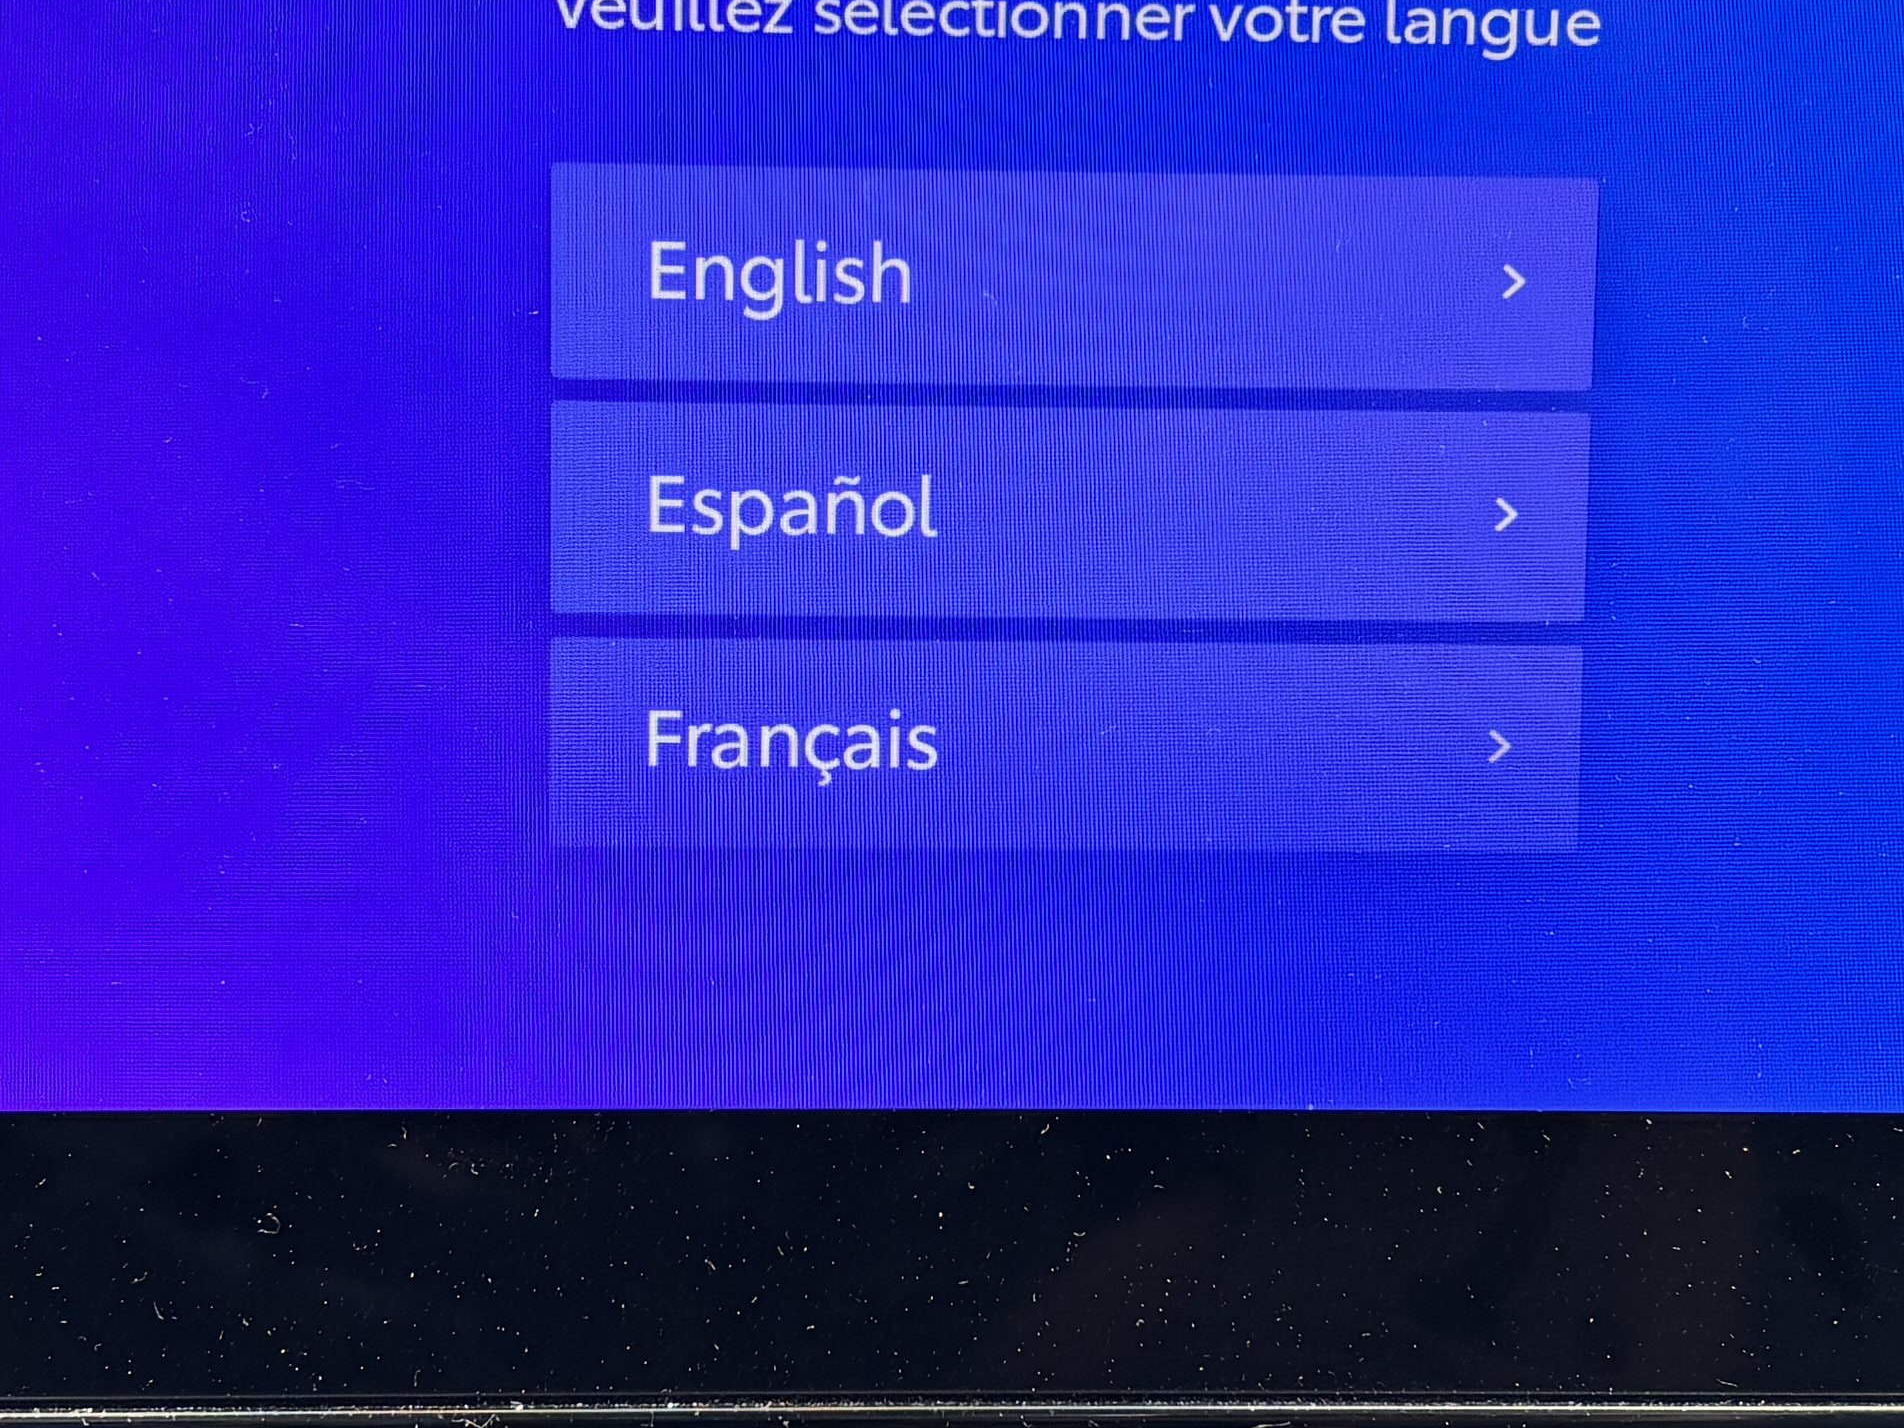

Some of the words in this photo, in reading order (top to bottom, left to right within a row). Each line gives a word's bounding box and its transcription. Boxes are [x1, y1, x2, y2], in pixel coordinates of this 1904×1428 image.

[649, 238, 912, 322] English
[648, 472, 939, 552] Español
[646, 706, 940, 788] Français
